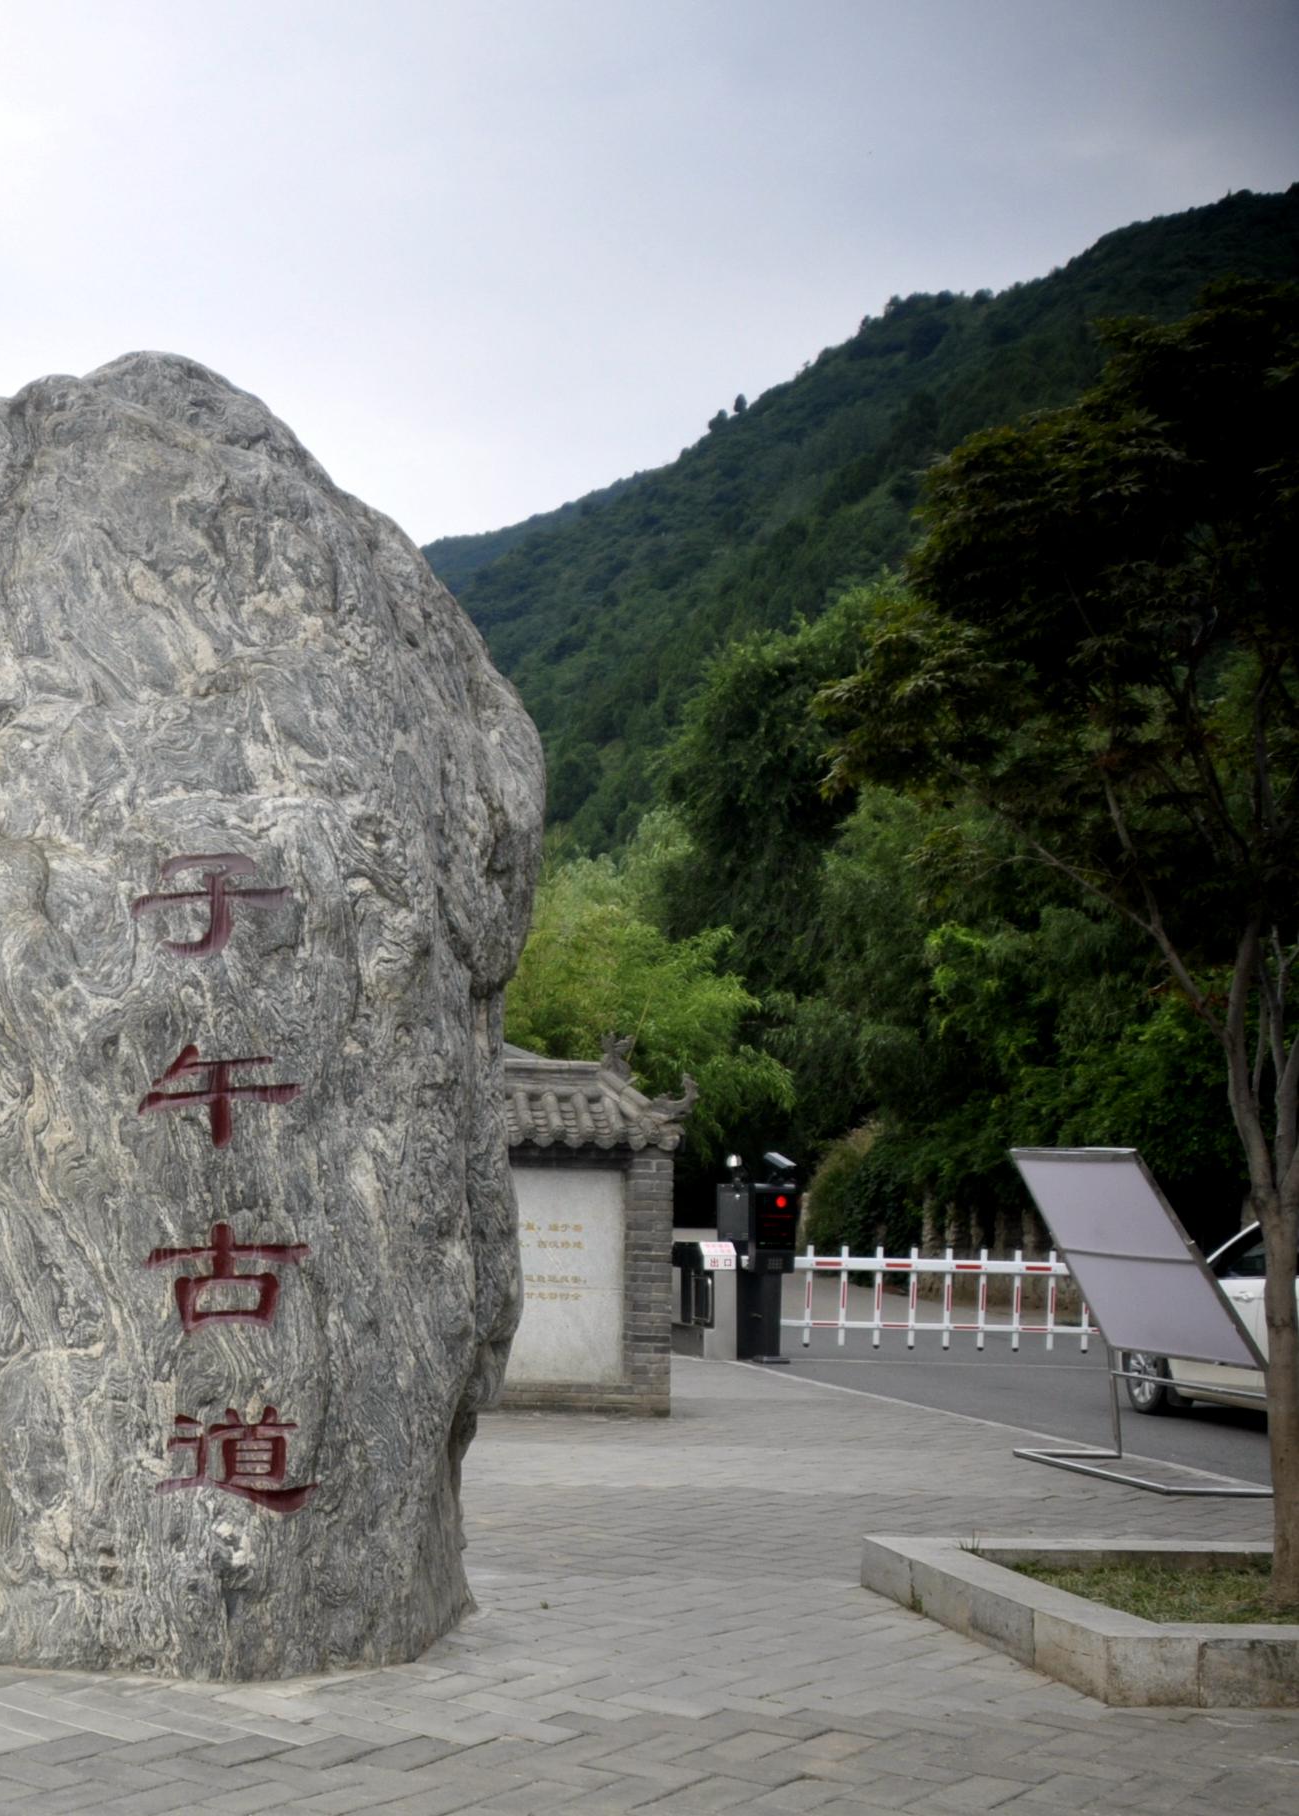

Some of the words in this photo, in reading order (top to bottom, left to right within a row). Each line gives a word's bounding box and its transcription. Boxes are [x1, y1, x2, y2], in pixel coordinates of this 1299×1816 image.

[131, 853, 320, 1513] 子午古道
[709, 1257, 732, 1267] 出口
